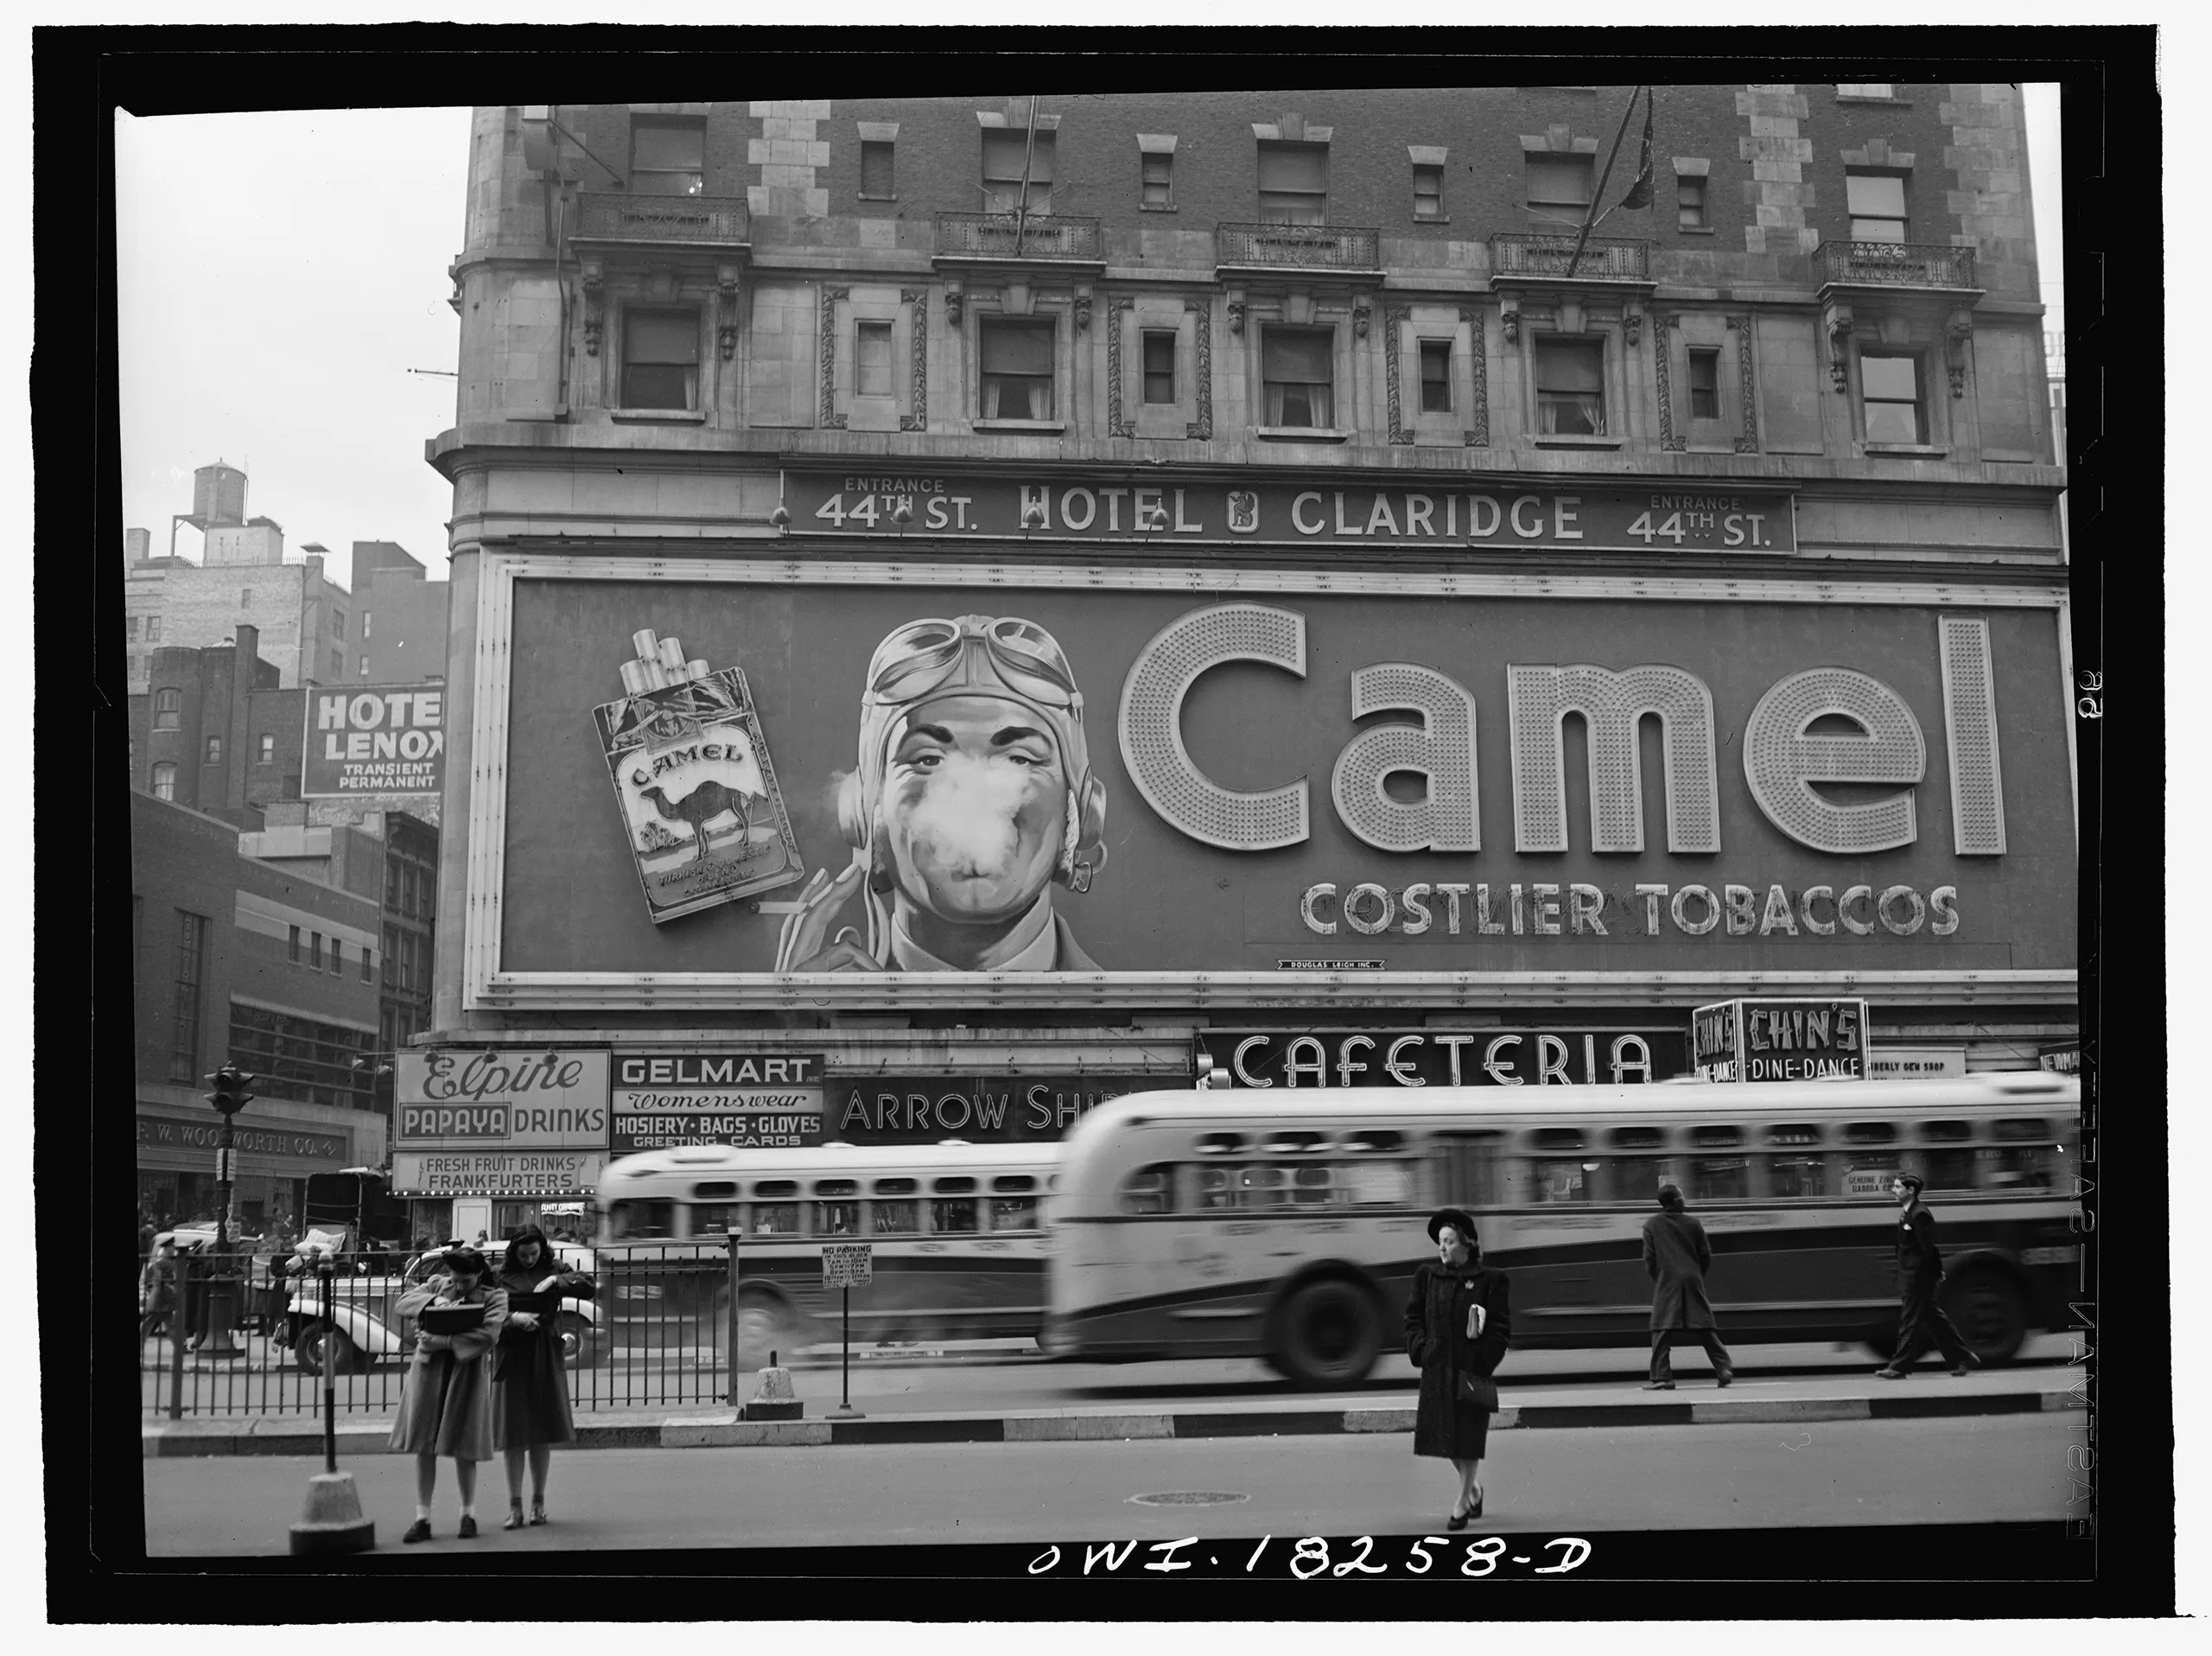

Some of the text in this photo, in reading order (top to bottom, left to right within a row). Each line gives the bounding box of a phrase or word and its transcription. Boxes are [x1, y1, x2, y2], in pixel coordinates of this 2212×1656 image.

[845, 477, 944, 493] ENTRANCE
[925, 496, 978, 530] ST.
[1019, 485, 1584, 540] HOTEL CLARIDGE
[1650, 495, 1740, 511] ENTRANCE
[1627, 511, 1770, 545] 44TH ST.
[318, 691, 444, 729] HOTE
[1117, 599, 2007, 857] Camel
[344, 762, 433, 775] TRANSIENT
[631, 743, 744, 787] CAMEL
[339, 776, 435, 788] PERMANENT
[658, 865, 703, 887] TURKISH
[697, 866, 739, 883] BLEND
[1300, 883, 1960, 936] COSTLIER TOBACCOS
[1750, 1003, 1858, 1052] CHIN'S
[622, 1059, 811, 1085] GELMART
[1233, 1035, 1652, 1087] CAFETERIA
[1904, 1062, 1920, 1072] GEM
[1923, 1062, 1945, 1072] SHOP
[423, 1055, 583, 1101] Elpine
[628, 1092, 807, 1111] Womenswear
[840, 1087, 1009, 1130] ARROW
[404, 1108, 604, 1134] PAPAYA DRINKS
[615, 1116, 820, 1135] HOSIERY BAGS GLOVES
[156, 1124, 172, 1141] W.
[181, 1126, 288, 1152] WOOWORTH
[294, 1137, 317, 1155] CO.
[633, 1135, 801, 1147] GREETING CARDS
[427, 1156, 575, 1172] FRESH FRUIT DRINKS
[429, 1174, 573, 1188] FRANKFURTERS
[836, 1245, 872, 1254] PARKING
